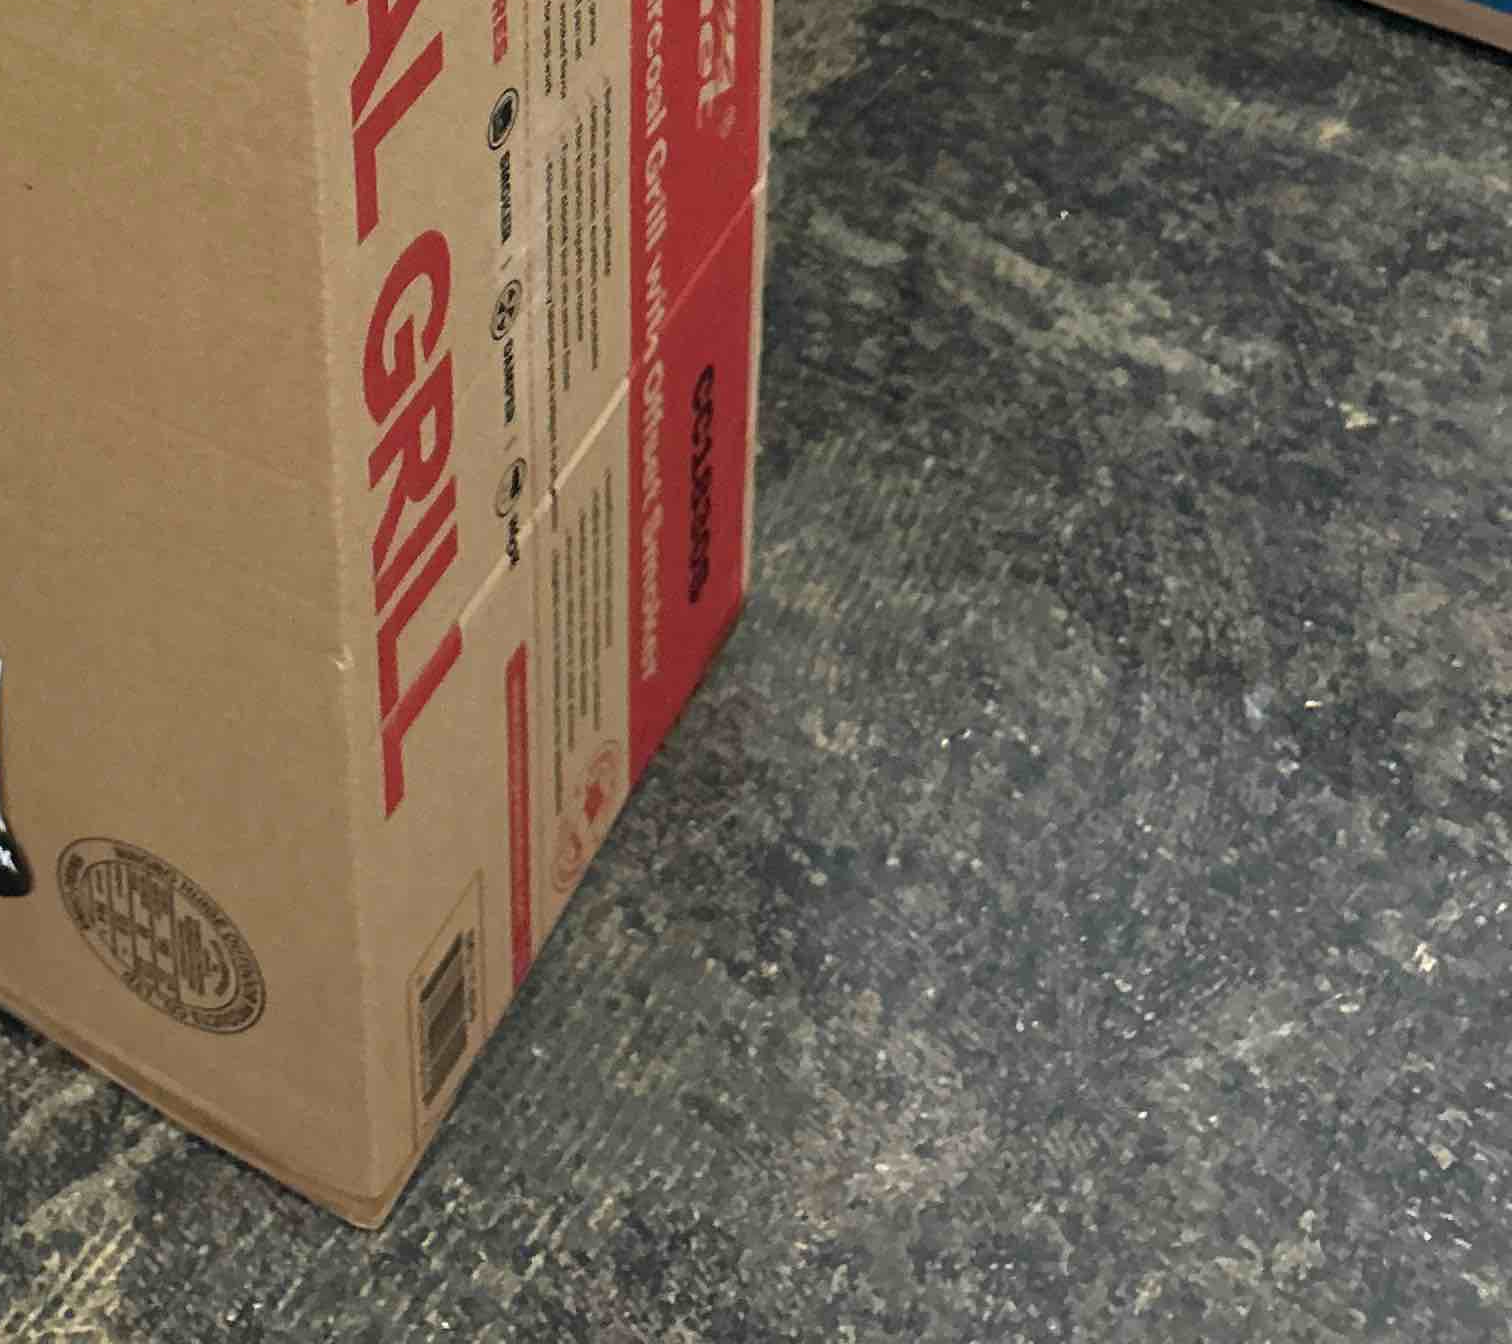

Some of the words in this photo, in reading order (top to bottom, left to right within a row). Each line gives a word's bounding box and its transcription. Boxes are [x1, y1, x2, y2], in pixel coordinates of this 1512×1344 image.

[644, 136, 669, 253] Grill
[641, 361, 666, 513] Offset
[362, 229, 464, 819] GRILL
[639, 505, 664, 680] Smoker
